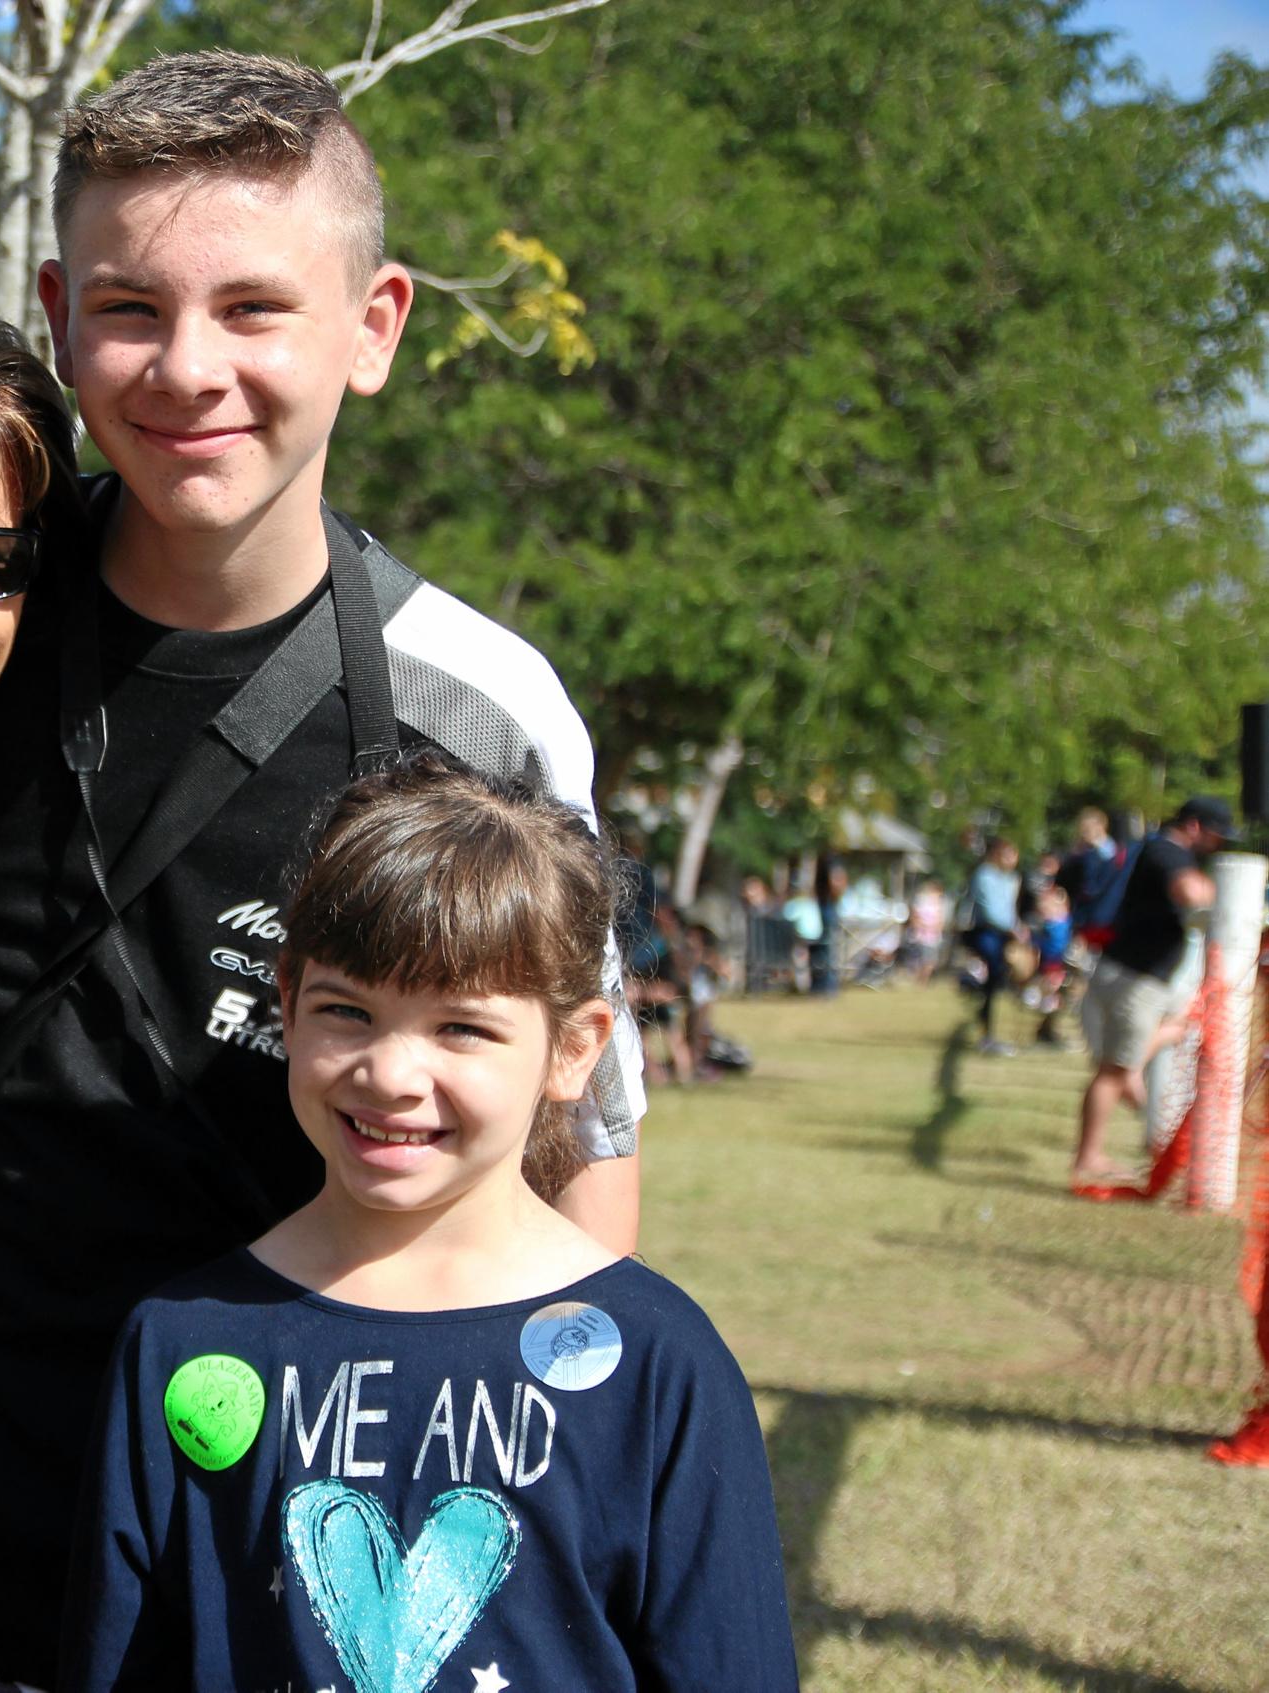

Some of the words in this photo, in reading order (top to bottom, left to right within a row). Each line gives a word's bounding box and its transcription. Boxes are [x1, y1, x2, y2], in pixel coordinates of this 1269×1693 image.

[197, 1359, 251, 1383] BLAZER
[246, 1382, 262, 1417] SAYS
[279, 1360, 394, 1479] ME
[413, 1377, 557, 1488] AND
